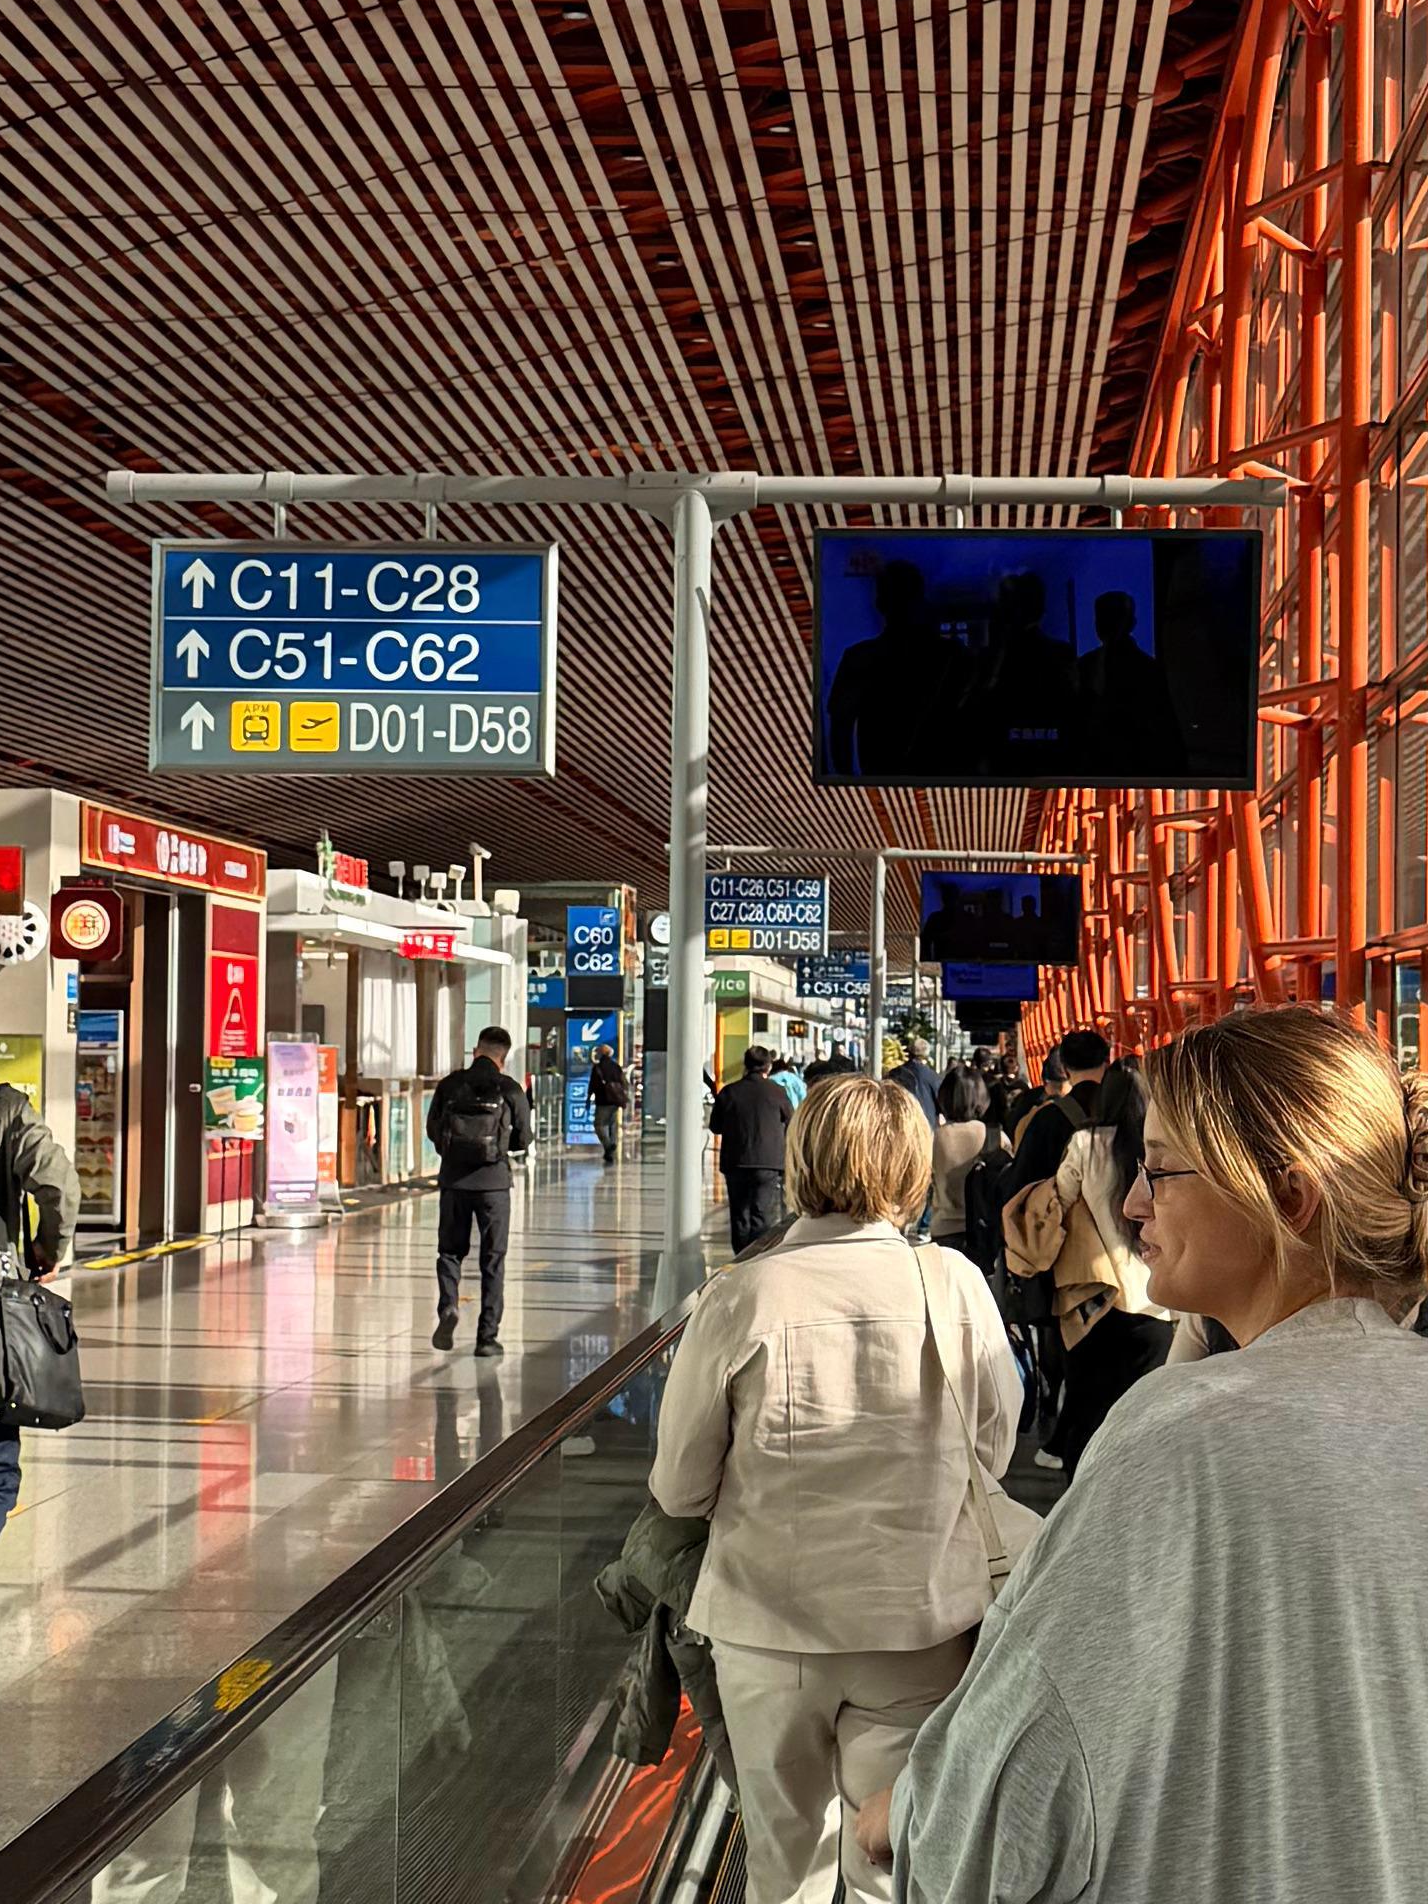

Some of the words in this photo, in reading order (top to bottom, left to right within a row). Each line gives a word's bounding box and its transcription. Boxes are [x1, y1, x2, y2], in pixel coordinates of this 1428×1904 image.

[229, 559, 481, 614] C11-C28
[228, 628, 481, 682] C51-C62
[243, 704, 271, 715] APM
[349, 702, 532, 755] D01-D58
[574, 925, 614, 945] C60
[753, 930, 821, 951] D01-D58
[574, 952, 614, 971] C62
